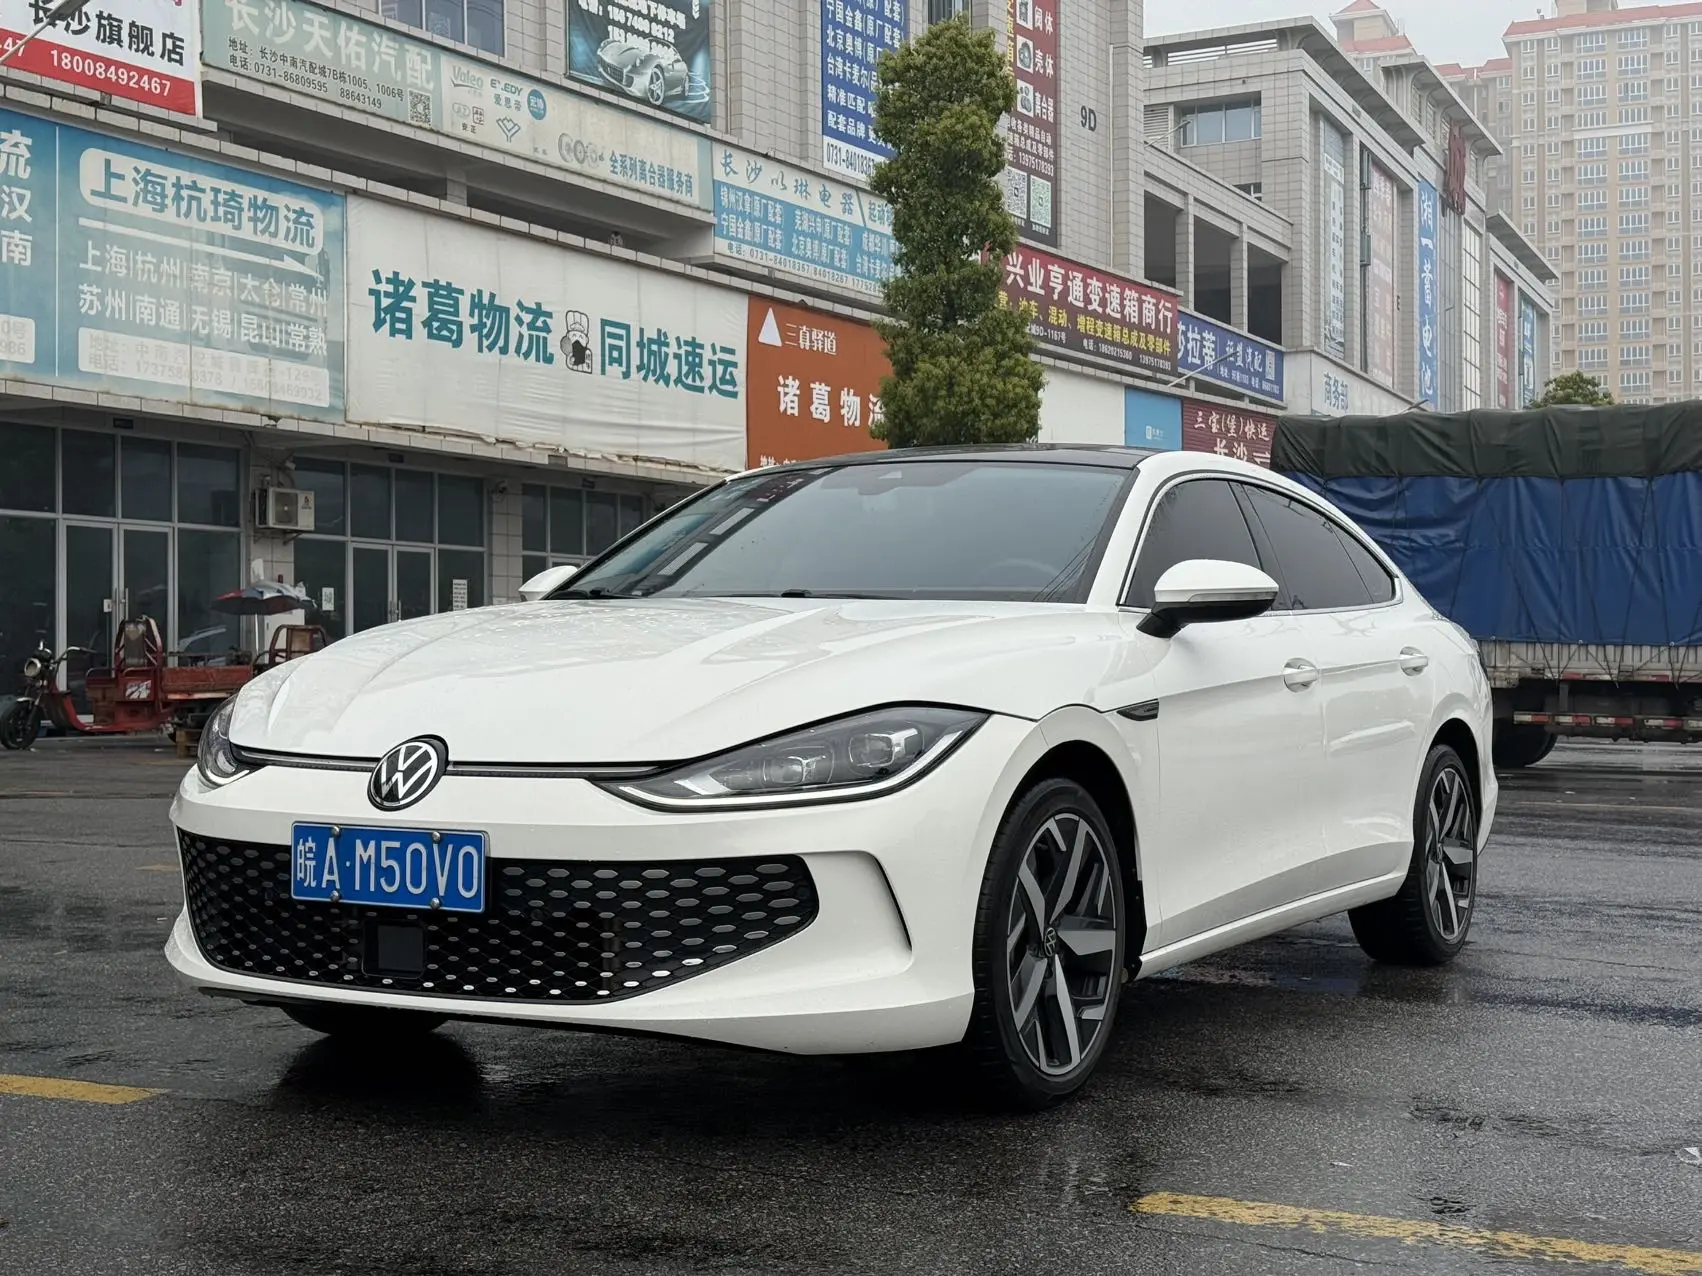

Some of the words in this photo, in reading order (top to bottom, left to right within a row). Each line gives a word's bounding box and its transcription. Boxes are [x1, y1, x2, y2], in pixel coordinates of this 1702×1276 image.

[28, 0, 185, 66] 长沙旗舰店
[225, 0, 435, 91] 长沙天佑汽配
[50, 49, 172, 97] 18008492467
[452, 65, 484, 88] Valeo
[490, 78, 524, 97] EEDY
[339, 87, 382, 109] 88643149
[827, 84, 866, 115] 精准匹配
[827, 110, 866, 141] 配套品牌
[1080, 105, 1097, 133] 9D
[90, 158, 315, 248] 上海杭琦物流
[2, 230, 32, 266] 南
[1005, 251, 1173, 335] 兴业亨通变速箱商行
[368, 269, 555, 366] 诸葛物流
[599, 317, 740, 400] 同城速运
[784, 322, 838, 356] 三真驿道
